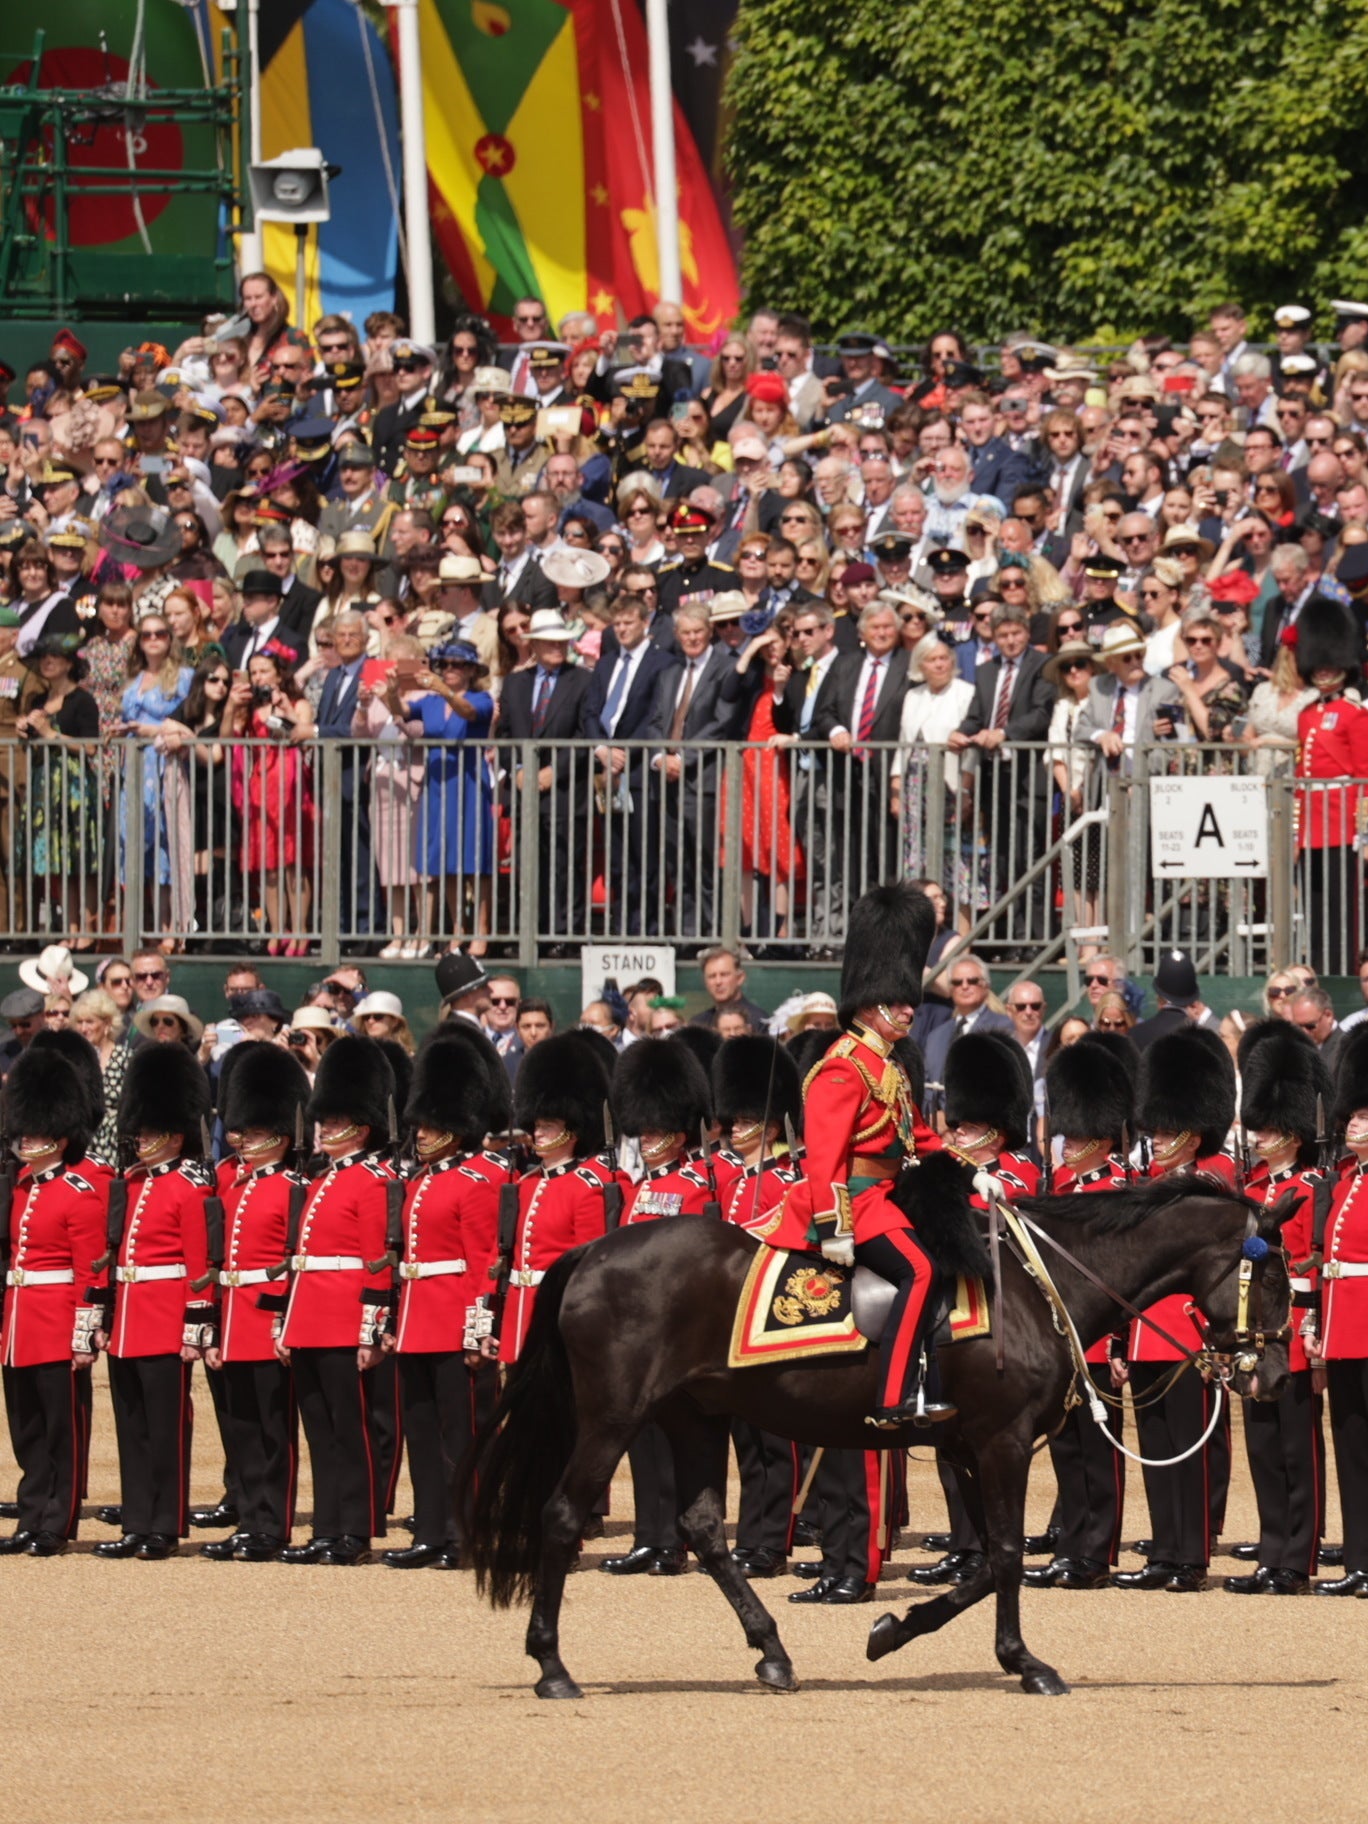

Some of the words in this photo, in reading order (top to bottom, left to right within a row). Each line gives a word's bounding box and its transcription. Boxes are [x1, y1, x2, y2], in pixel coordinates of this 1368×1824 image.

[1155, 783, 1183, 793] BLOCK
[1230, 783, 1258, 792] BLOCK
[1194, 803, 1224, 848] A
[1158, 831, 1184, 840] SEATS
[1232, 830, 1258, 839] SEATS
[602, 954, 656, 970] STAND
